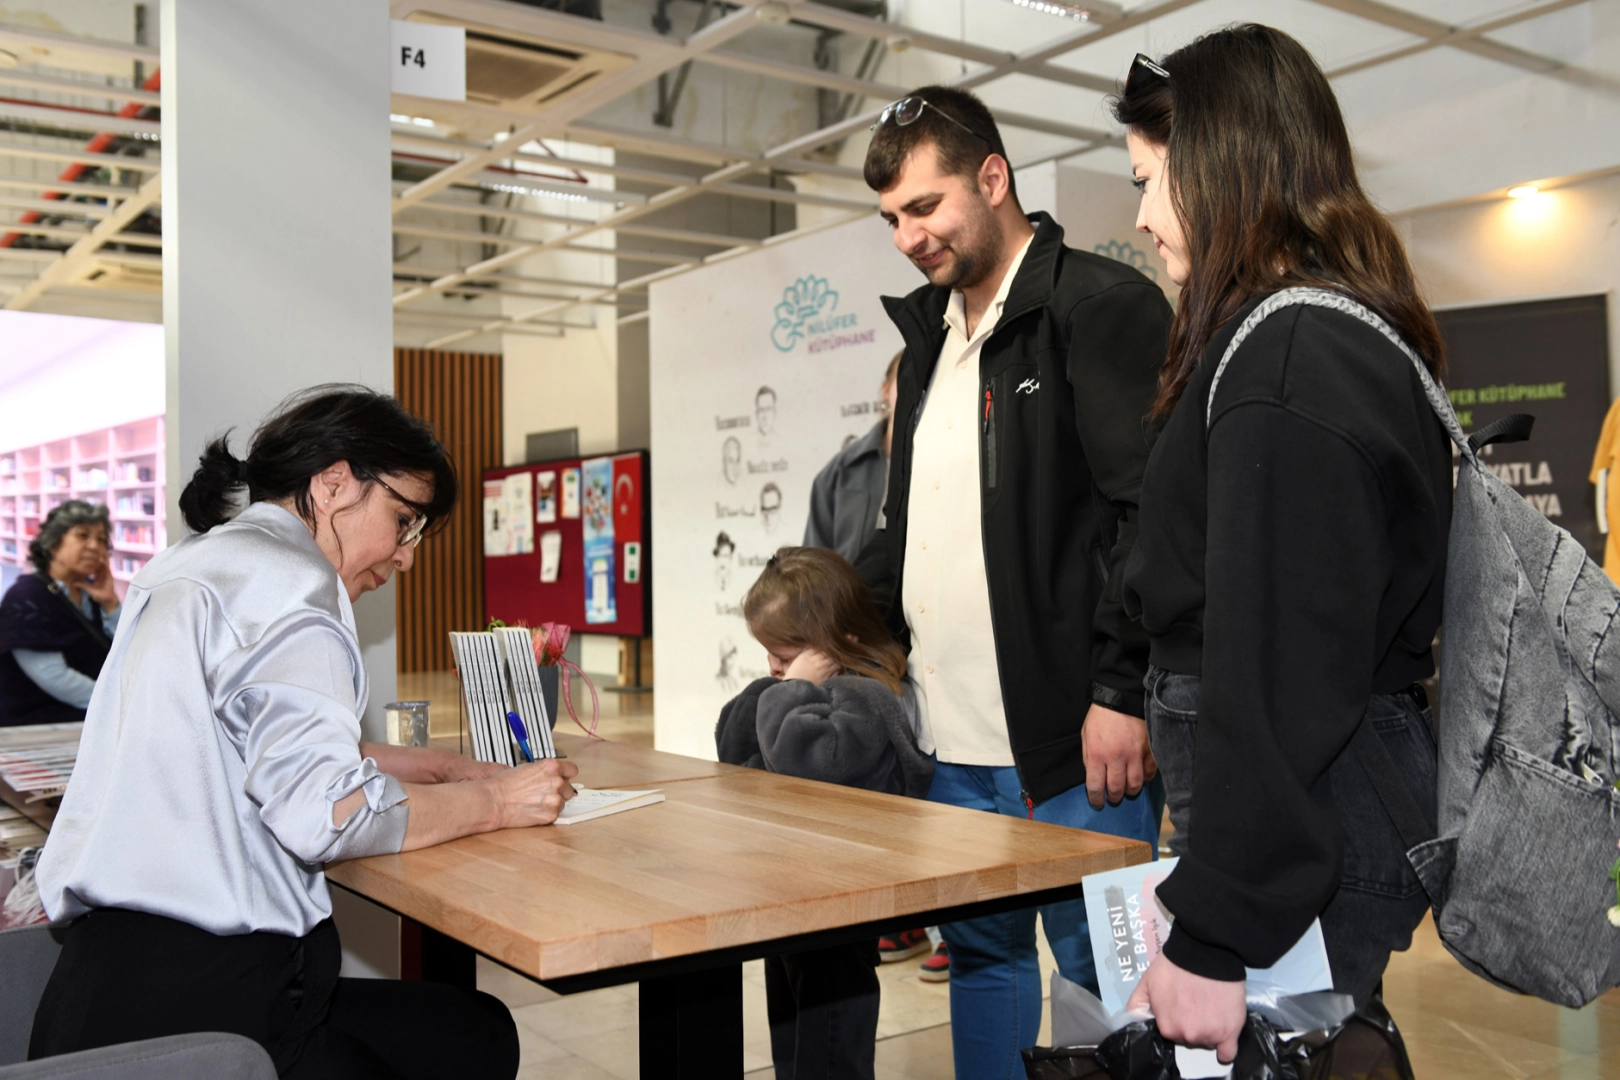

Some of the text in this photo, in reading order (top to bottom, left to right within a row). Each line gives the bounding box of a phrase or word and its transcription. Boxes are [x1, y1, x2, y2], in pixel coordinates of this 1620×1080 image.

[401, 46, 426, 68] F4
[1107, 906, 1134, 982] NE YENİ
[1127, 893, 1147, 954] BAŞKA
